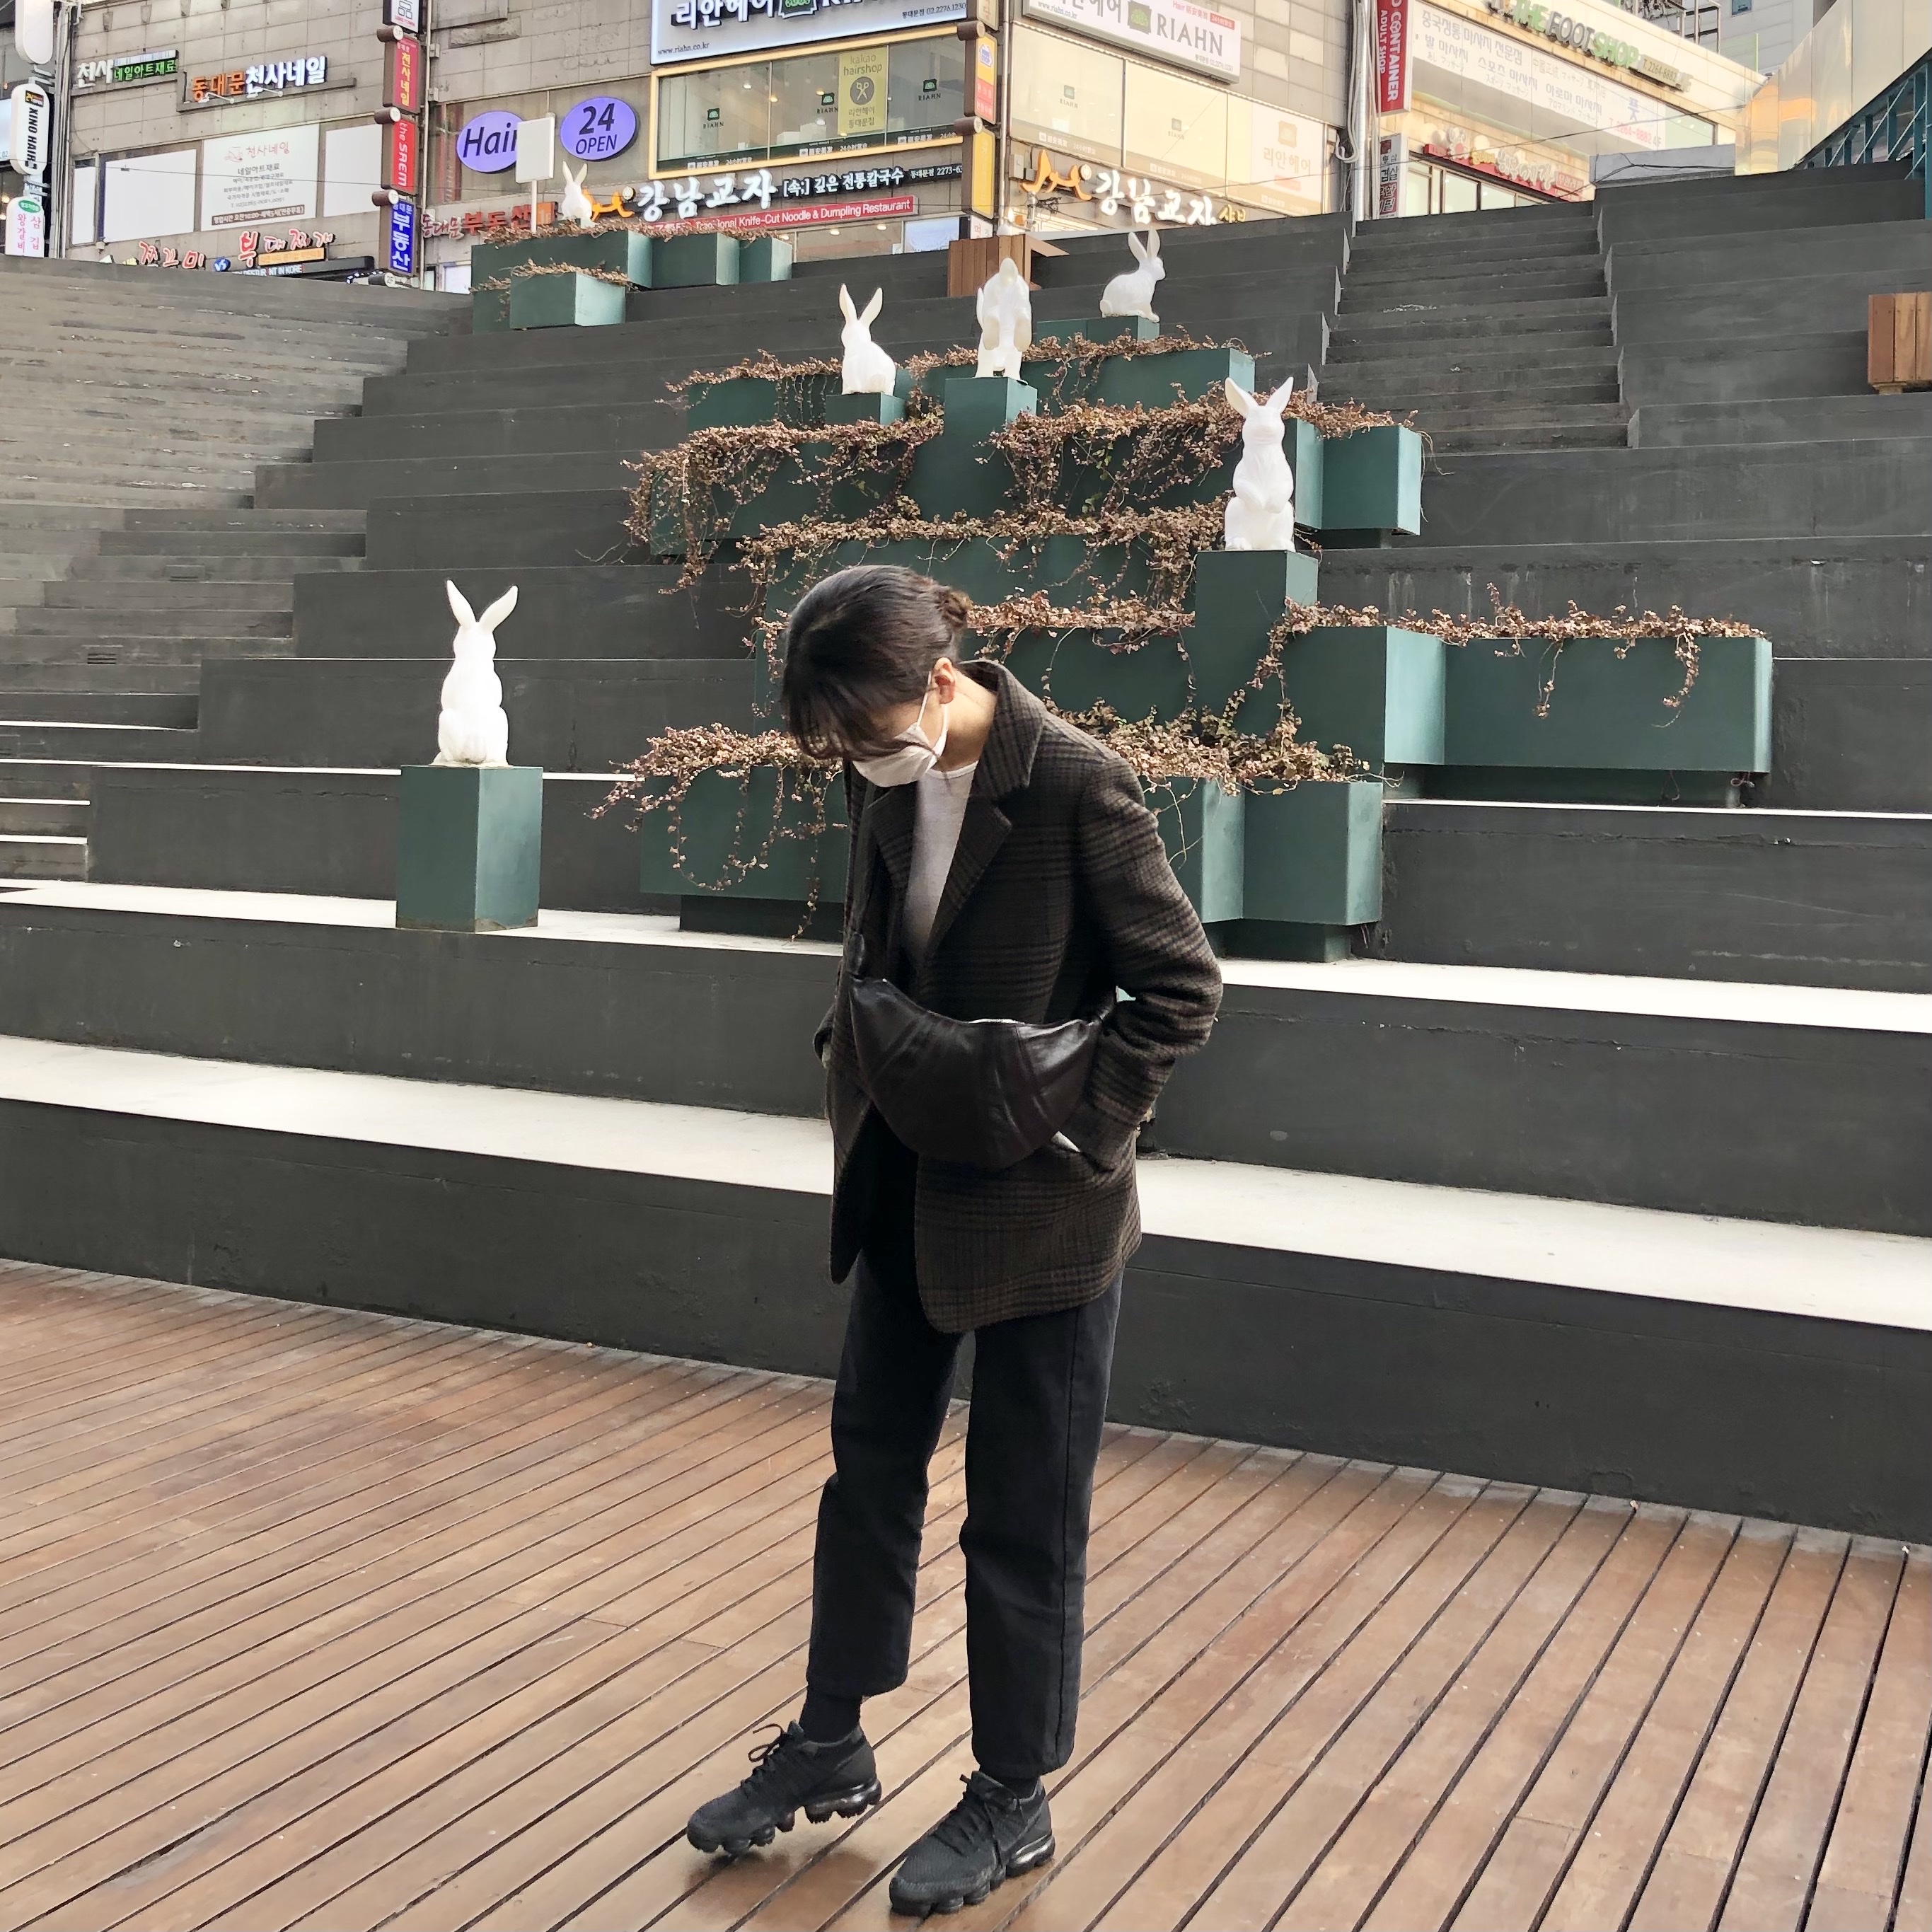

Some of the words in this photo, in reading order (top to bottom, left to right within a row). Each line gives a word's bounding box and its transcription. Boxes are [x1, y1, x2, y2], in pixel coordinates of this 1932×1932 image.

[1157, 13, 1223, 57] RIAHN
[1379, 9, 1388, 44] ADULT
[1547, 11, 1595, 52] FOOT
[1590, 31, 1640, 67] SHOP
[113, 59, 176, 82] 네일아트재료
[843, 63, 883, 76] hairshop
[850, 54, 877, 64] kakao
[1387, 11, 1402, 103] CONTAINER
[77, 59, 114, 88] 천사
[400, 52, 411, 107] 천사네일
[919, 93, 942, 101] RIAHN
[398, 122, 408, 141] the
[579, 103, 615, 136] 24
[27, 135, 38, 162] HAIR
[463, 122, 517, 158] Hair
[575, 134, 618, 156] OPEN
[237, 163, 280, 176] 네일아트재료
[398, 141, 408, 187] SAEM
[1263, 146, 1312, 177] 리안헤어
[637, 169, 778, 222] 강남교자
[814, 175, 839, 194] 깊은
[842, 167, 905, 191] 전통칼국수
[739, 211, 780, 228] Knife-Cut
[781, 210, 811, 223] Noodle
[813, 209, 819, 219] &
[820, 204, 862, 221] Dumpling
[862, 199, 910, 215] Restaurant
[1095, 170, 1217, 226] 강남교자
[17, 213, 27, 254] 왕갈비
[391, 211, 412, 272] 부동산
[214, 260, 227, 272] VS
